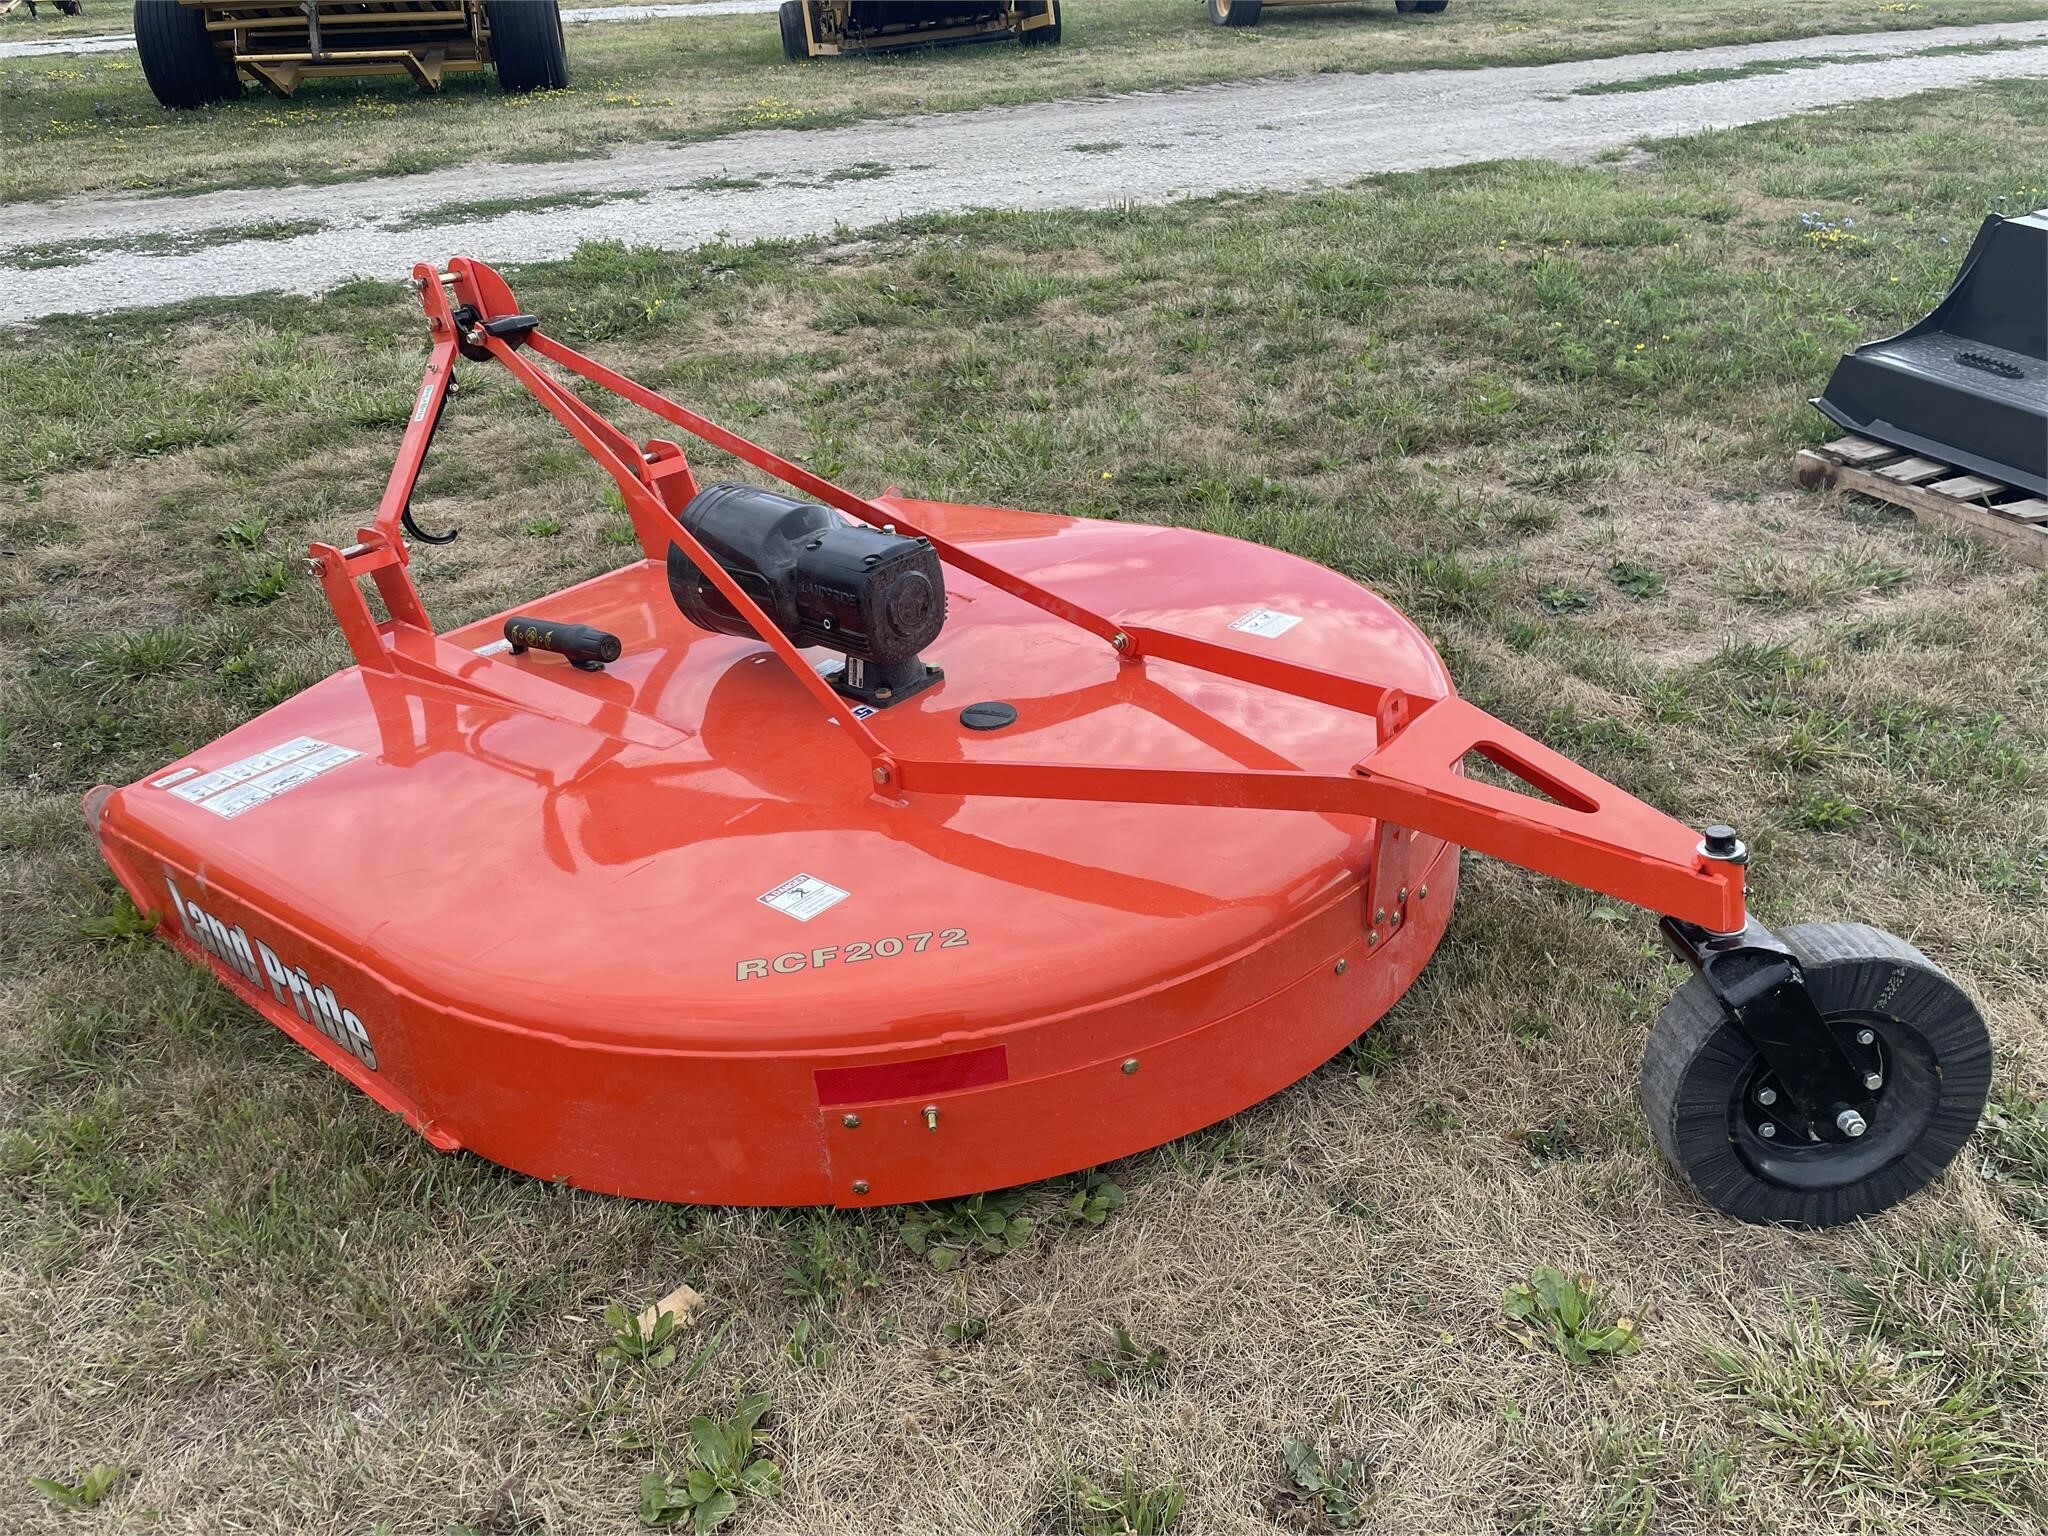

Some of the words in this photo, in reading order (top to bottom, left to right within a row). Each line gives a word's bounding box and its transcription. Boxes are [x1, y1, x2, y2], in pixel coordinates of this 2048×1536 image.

[164, 876, 266, 991] Land
[254, 936, 378, 1072] Pride
[735, 927, 970, 982] RCF2072
